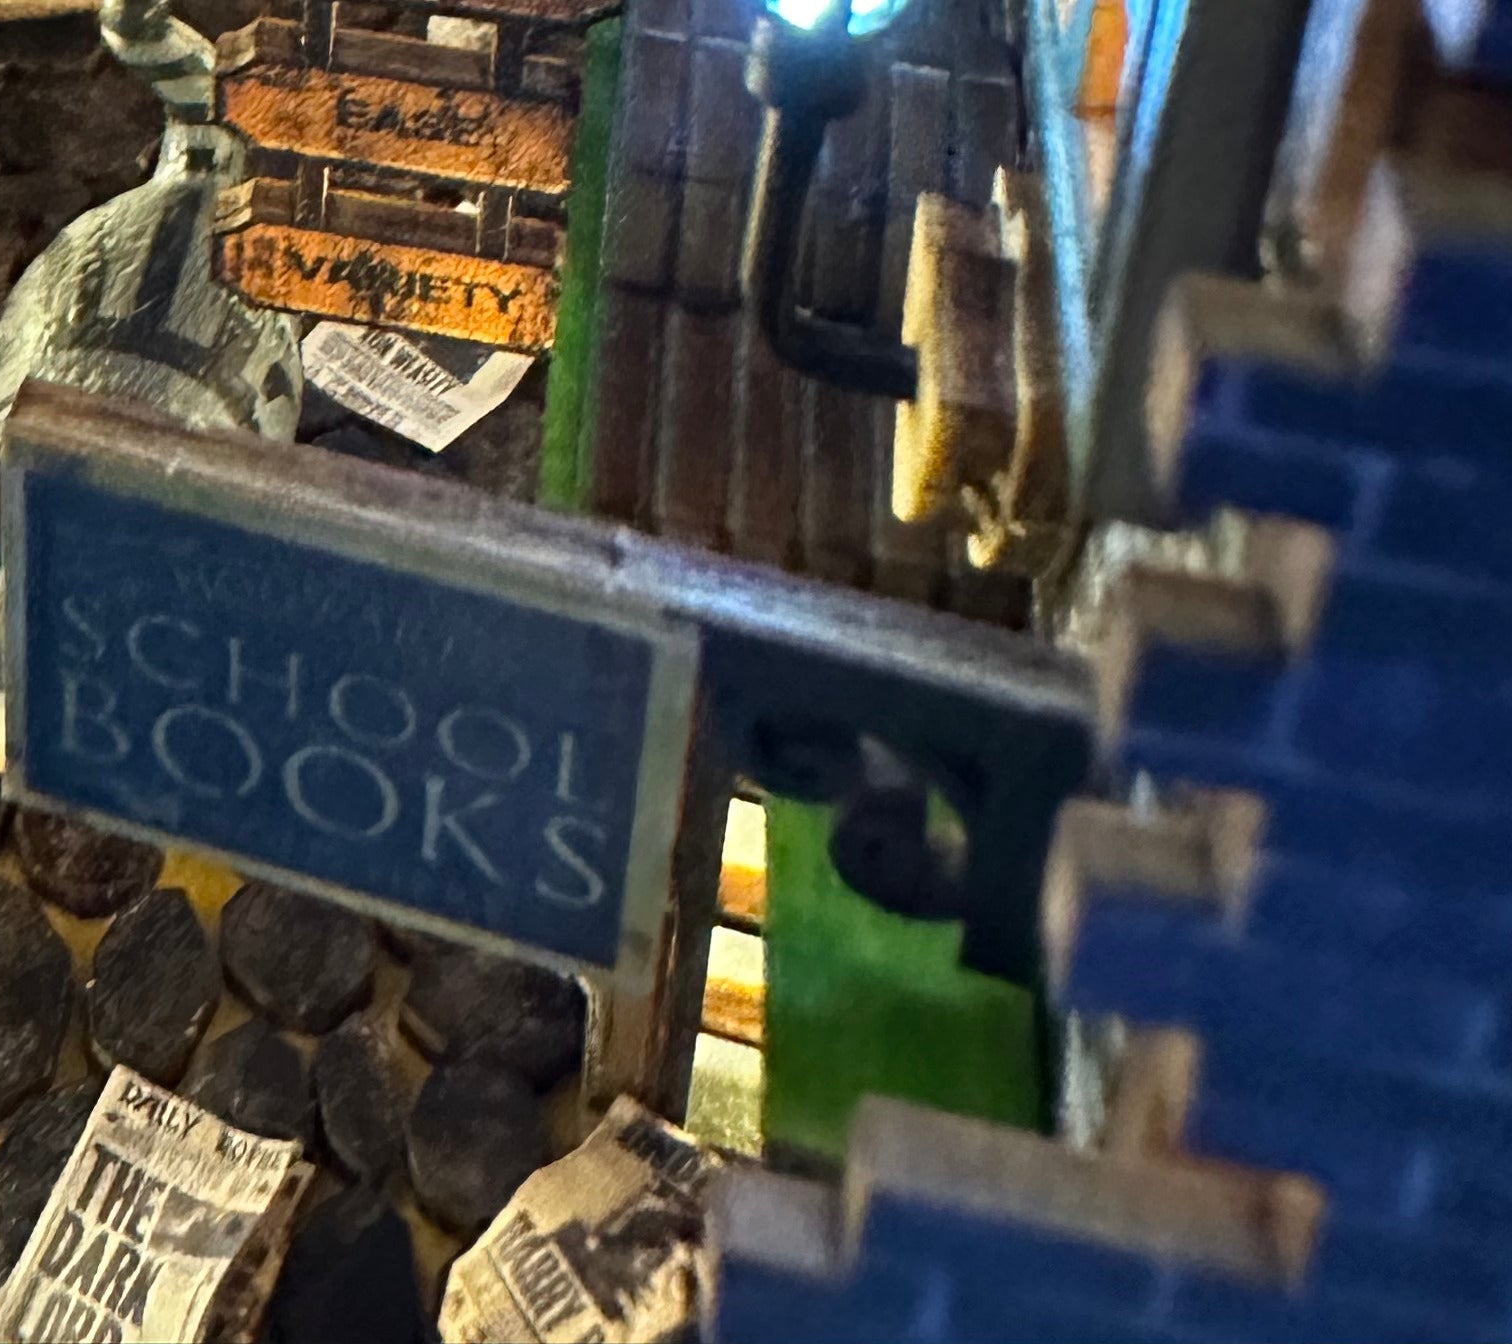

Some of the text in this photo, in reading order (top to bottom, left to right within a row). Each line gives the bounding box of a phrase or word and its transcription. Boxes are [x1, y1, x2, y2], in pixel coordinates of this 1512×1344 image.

[61, 595, 603, 806] SCHOOL
[58, 667, 606, 908] BOOKS
[117, 1079, 204, 1141] DAILY
[74, 1142, 170, 1244] THE
[37, 1209, 166, 1329] DARK
